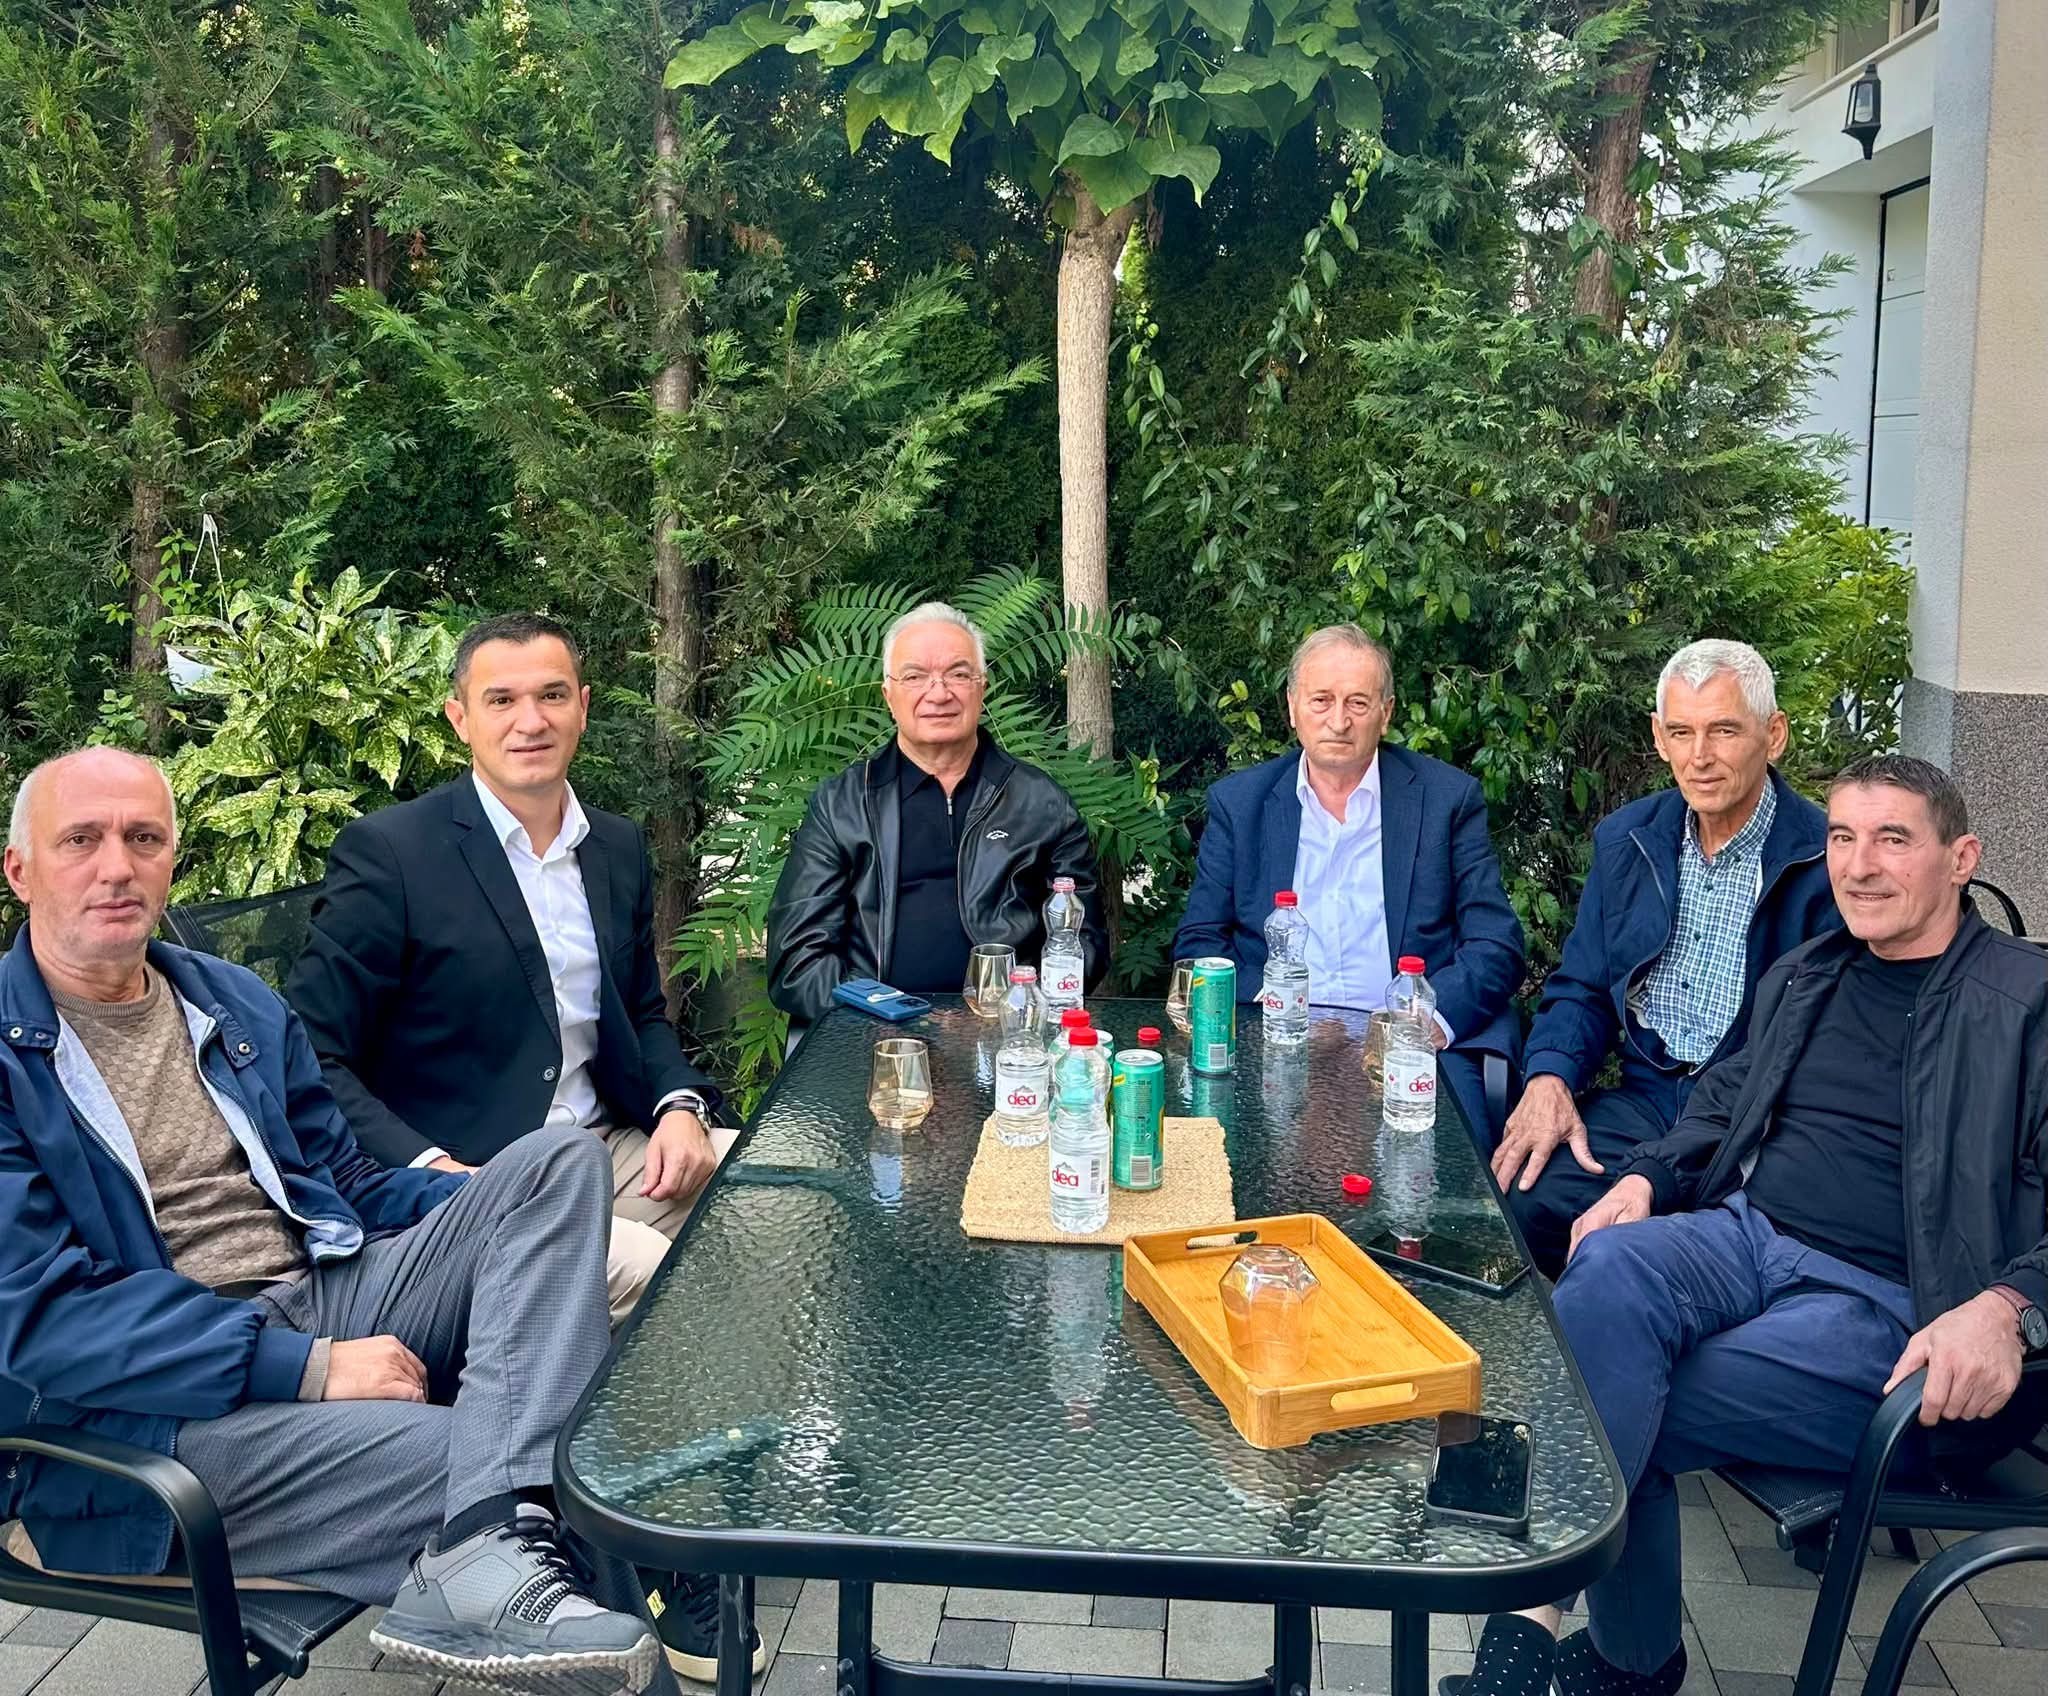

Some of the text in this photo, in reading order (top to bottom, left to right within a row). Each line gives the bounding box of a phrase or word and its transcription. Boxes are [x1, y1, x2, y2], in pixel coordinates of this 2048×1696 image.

[1057, 979, 1080, 990] dea
[1408, 1079, 1434, 1093] dea
[1007, 1091, 1037, 1106] dea
[1051, 1167, 1079, 1187] dea
